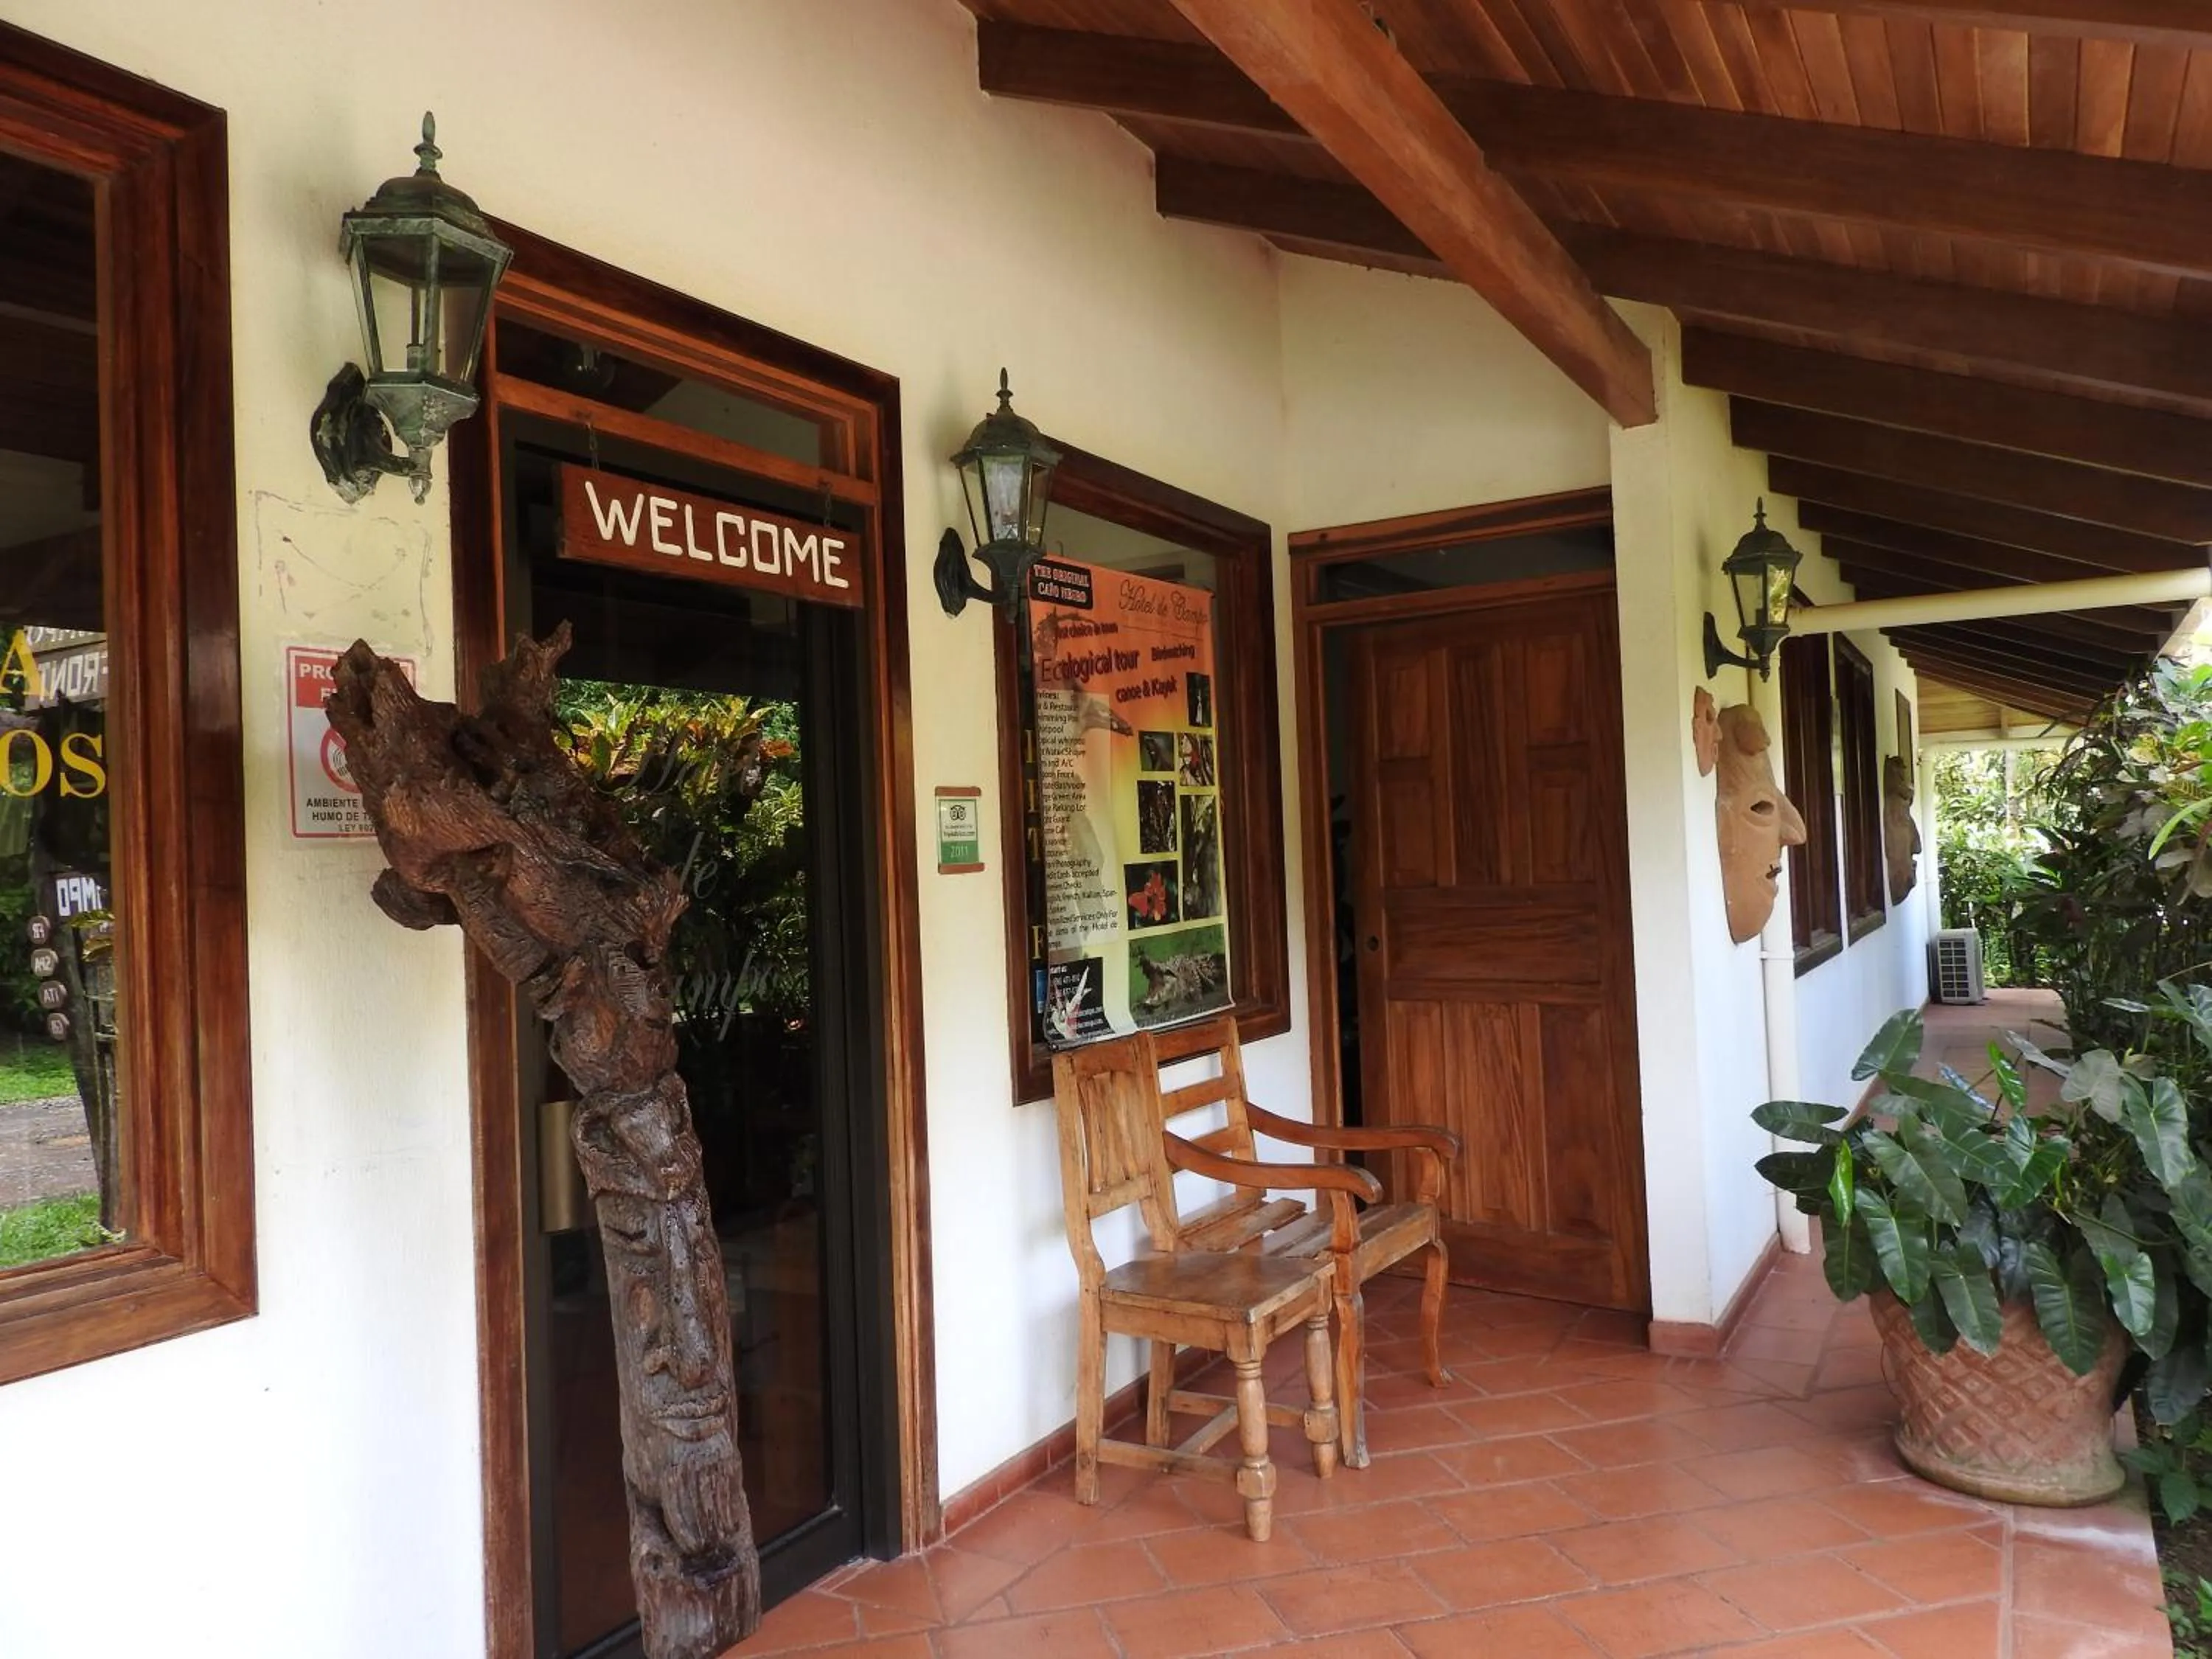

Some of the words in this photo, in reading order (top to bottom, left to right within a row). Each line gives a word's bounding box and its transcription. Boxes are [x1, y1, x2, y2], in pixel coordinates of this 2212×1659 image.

[584, 481, 849, 589] WELCOME
[1041, 646, 1113, 684] Ecological
[1113, 649, 1140, 672] tour
[306, 799, 358, 808] AMBIENTE
[312, 812, 344, 821] HUMO
[346, 812, 360, 821] DE
[338, 824, 356, 832] LEY
